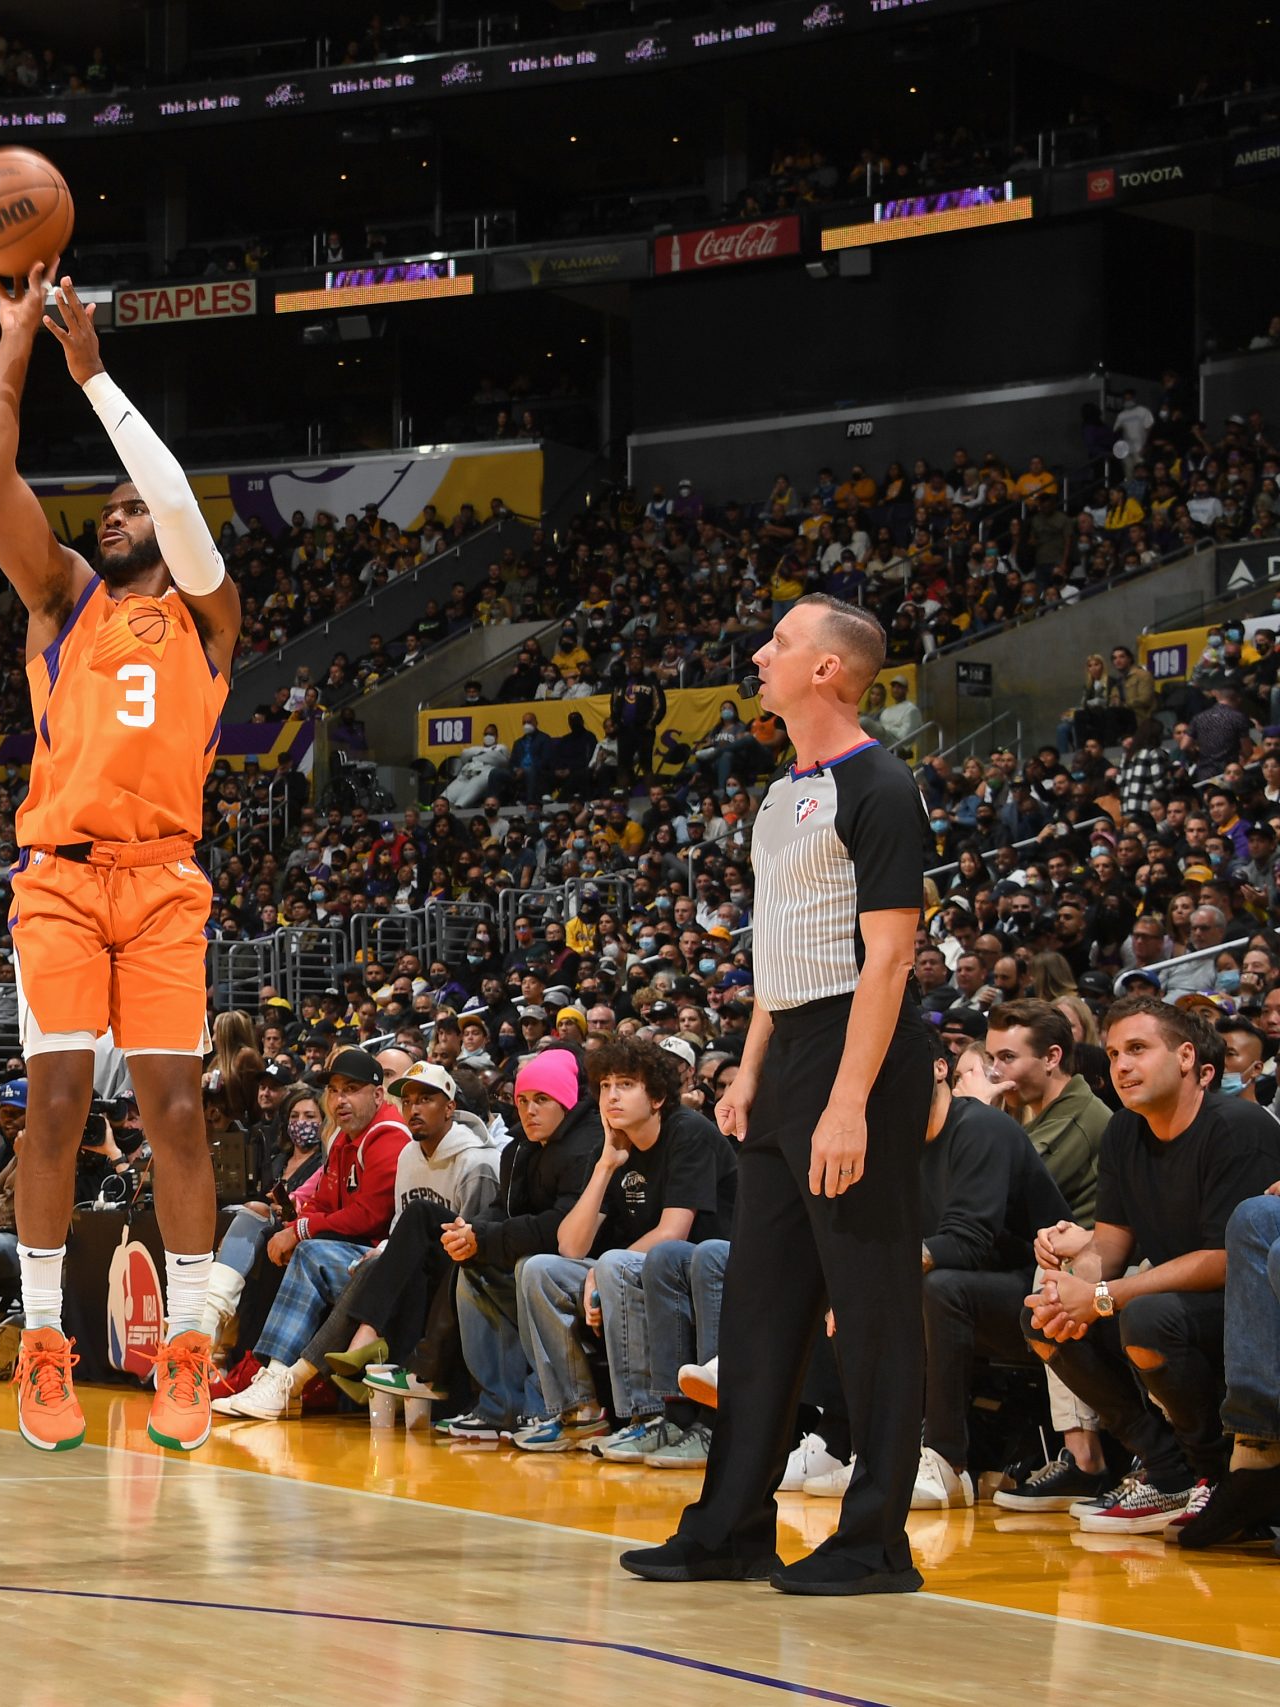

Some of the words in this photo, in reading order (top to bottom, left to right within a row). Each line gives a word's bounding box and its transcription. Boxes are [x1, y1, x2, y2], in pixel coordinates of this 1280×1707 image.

[694, 31, 719, 47] This
[720, 29, 732, 42] is
[734, 25, 754, 39] the
[510, 58, 538, 73] This
[540, 56, 551, 69] is
[553, 54, 574, 67] the
[331, 81, 358, 95] This
[359, 79, 371, 91] is
[373, 76, 392, 90] the
[160, 101, 184, 115] This
[186, 100, 198, 112] is
[11, 114, 23, 126] is
[1119, 166, 1184, 188] TOYOTA
[119, 283, 252, 323] STAPLES
[847, 421, 873, 437] PR10
[1152, 649, 1180, 677] 109
[116, 664, 156, 728] 3
[435, 720, 464, 743] 108
[143, 1295, 158, 1322] NBA
[127, 1325, 159, 1345] ESPN
